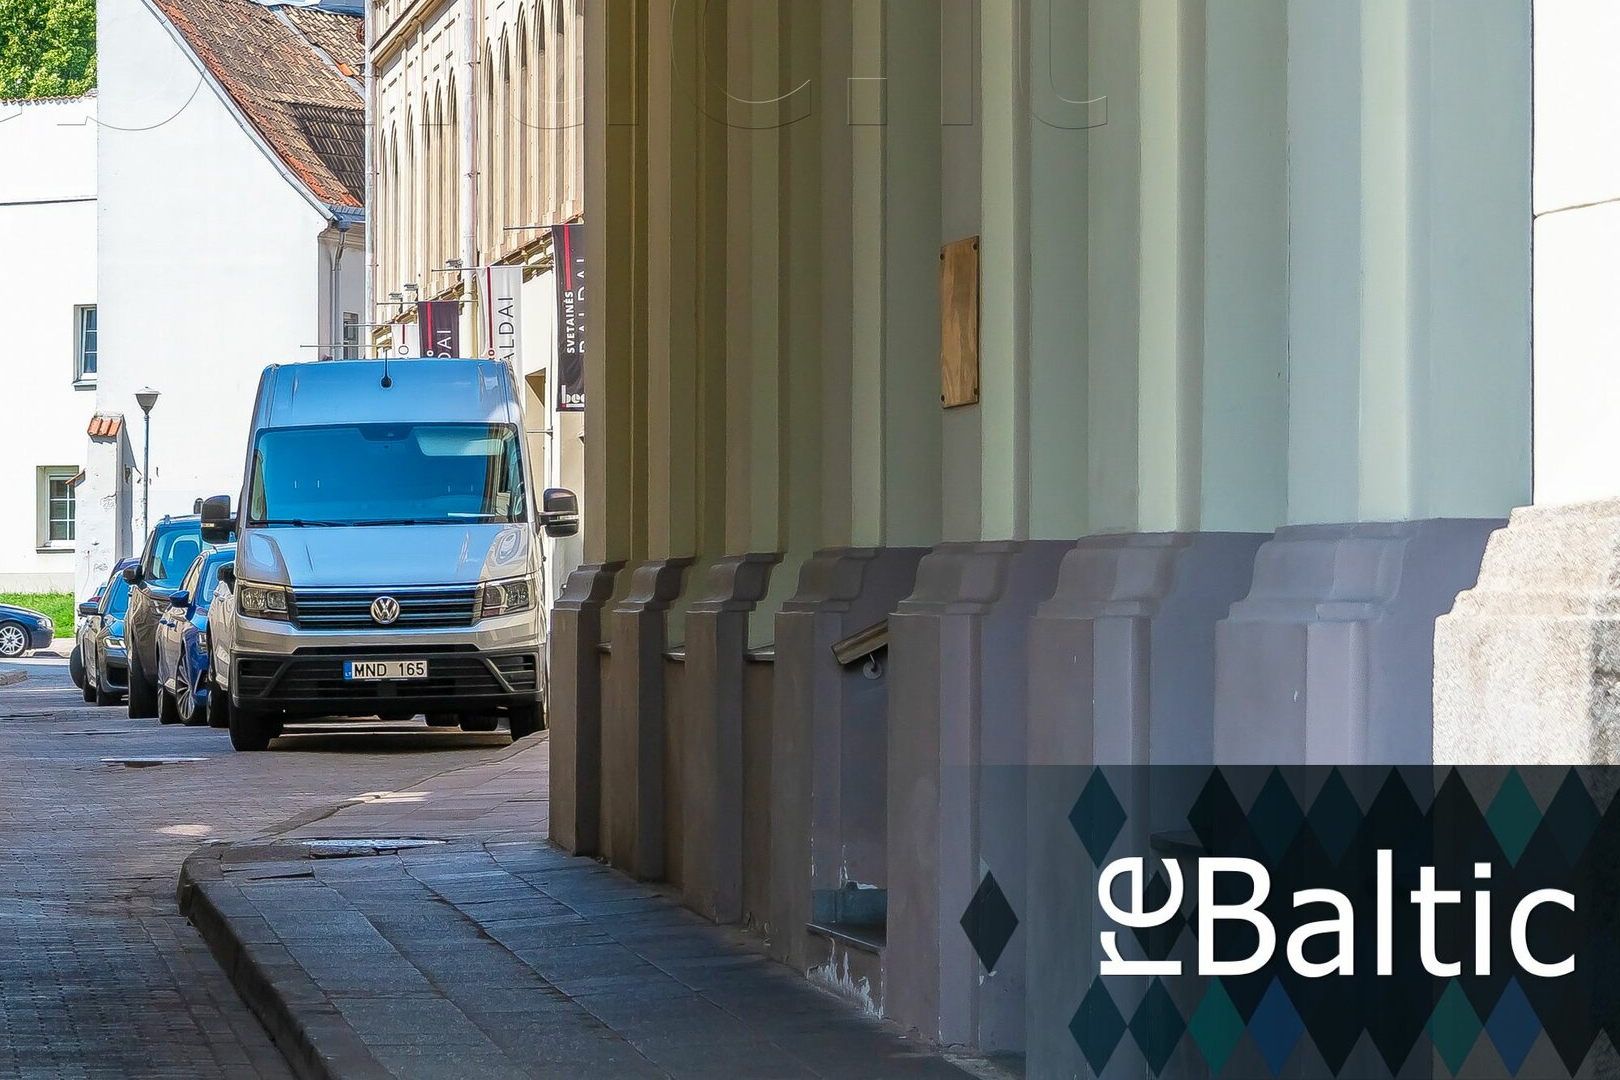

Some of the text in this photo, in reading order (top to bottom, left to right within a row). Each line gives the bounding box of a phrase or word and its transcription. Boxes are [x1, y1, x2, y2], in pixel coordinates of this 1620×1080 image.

[564, 290, 576, 354] SVETAINĖS
[354, 662, 424, 677] MND 165
